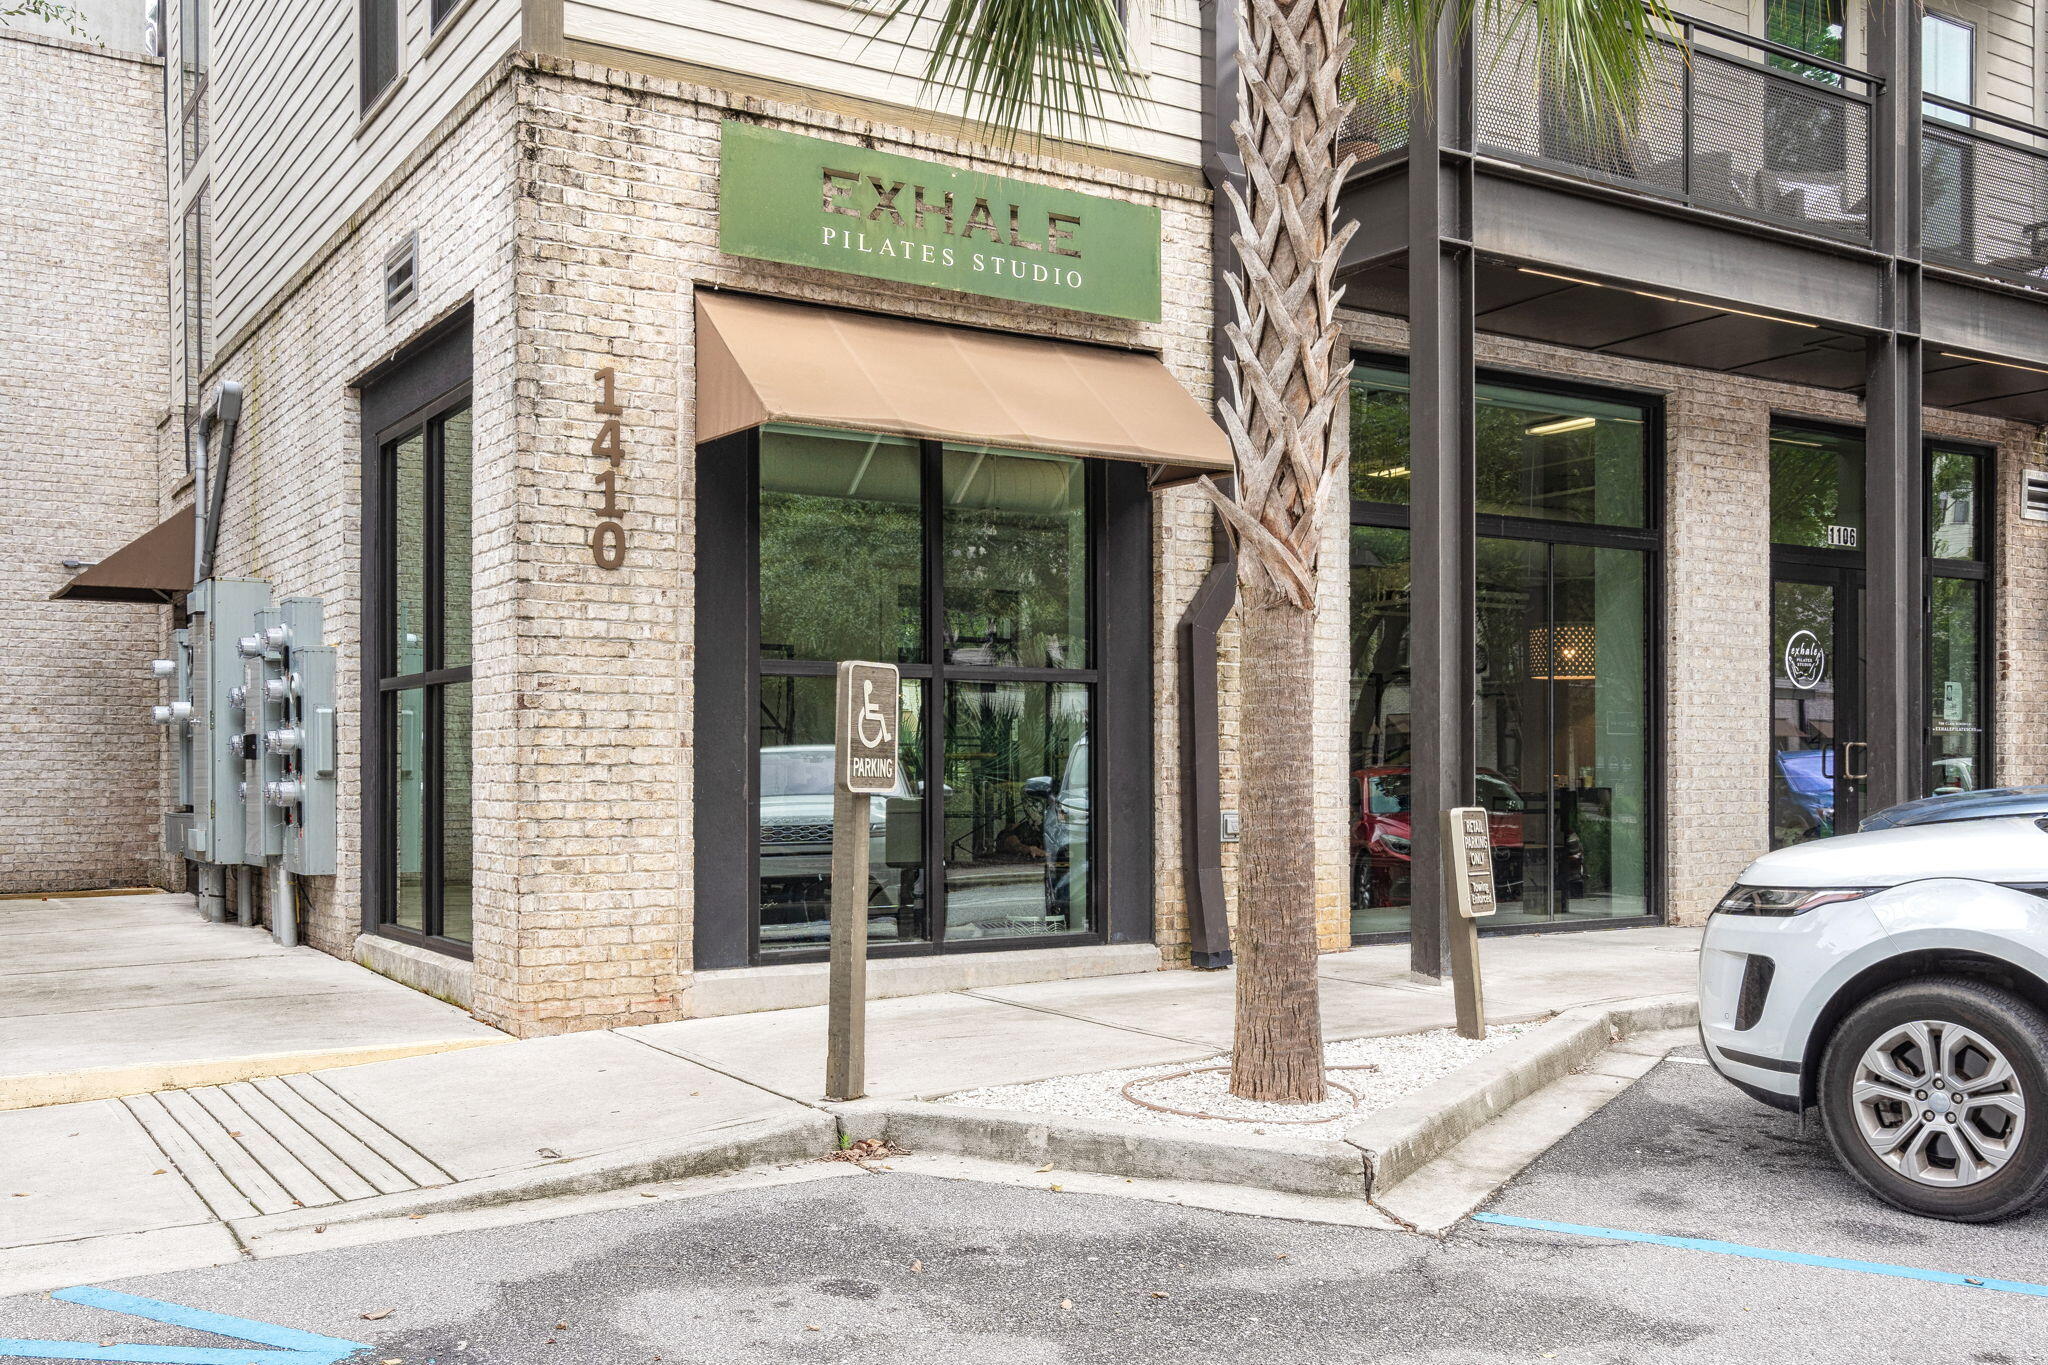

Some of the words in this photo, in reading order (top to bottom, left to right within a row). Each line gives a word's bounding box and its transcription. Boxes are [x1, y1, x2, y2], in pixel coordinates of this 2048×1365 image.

[822, 166, 1081, 259] EXHALE
[822, 226, 955, 267] PILATES
[972, 252, 1083, 289] STUDIO
[591, 366, 626, 570] 1410
[1829, 526, 1856, 546] 1106
[1790, 642, 1818, 657] exhale
[853, 757, 893, 778] PARKING
[1464, 819, 1484, 833] RETAIL
[1464, 836, 1488, 849] PARKING
[1470, 852, 1484, 866] ONLY
[1471, 881, 1490, 894] Towing
